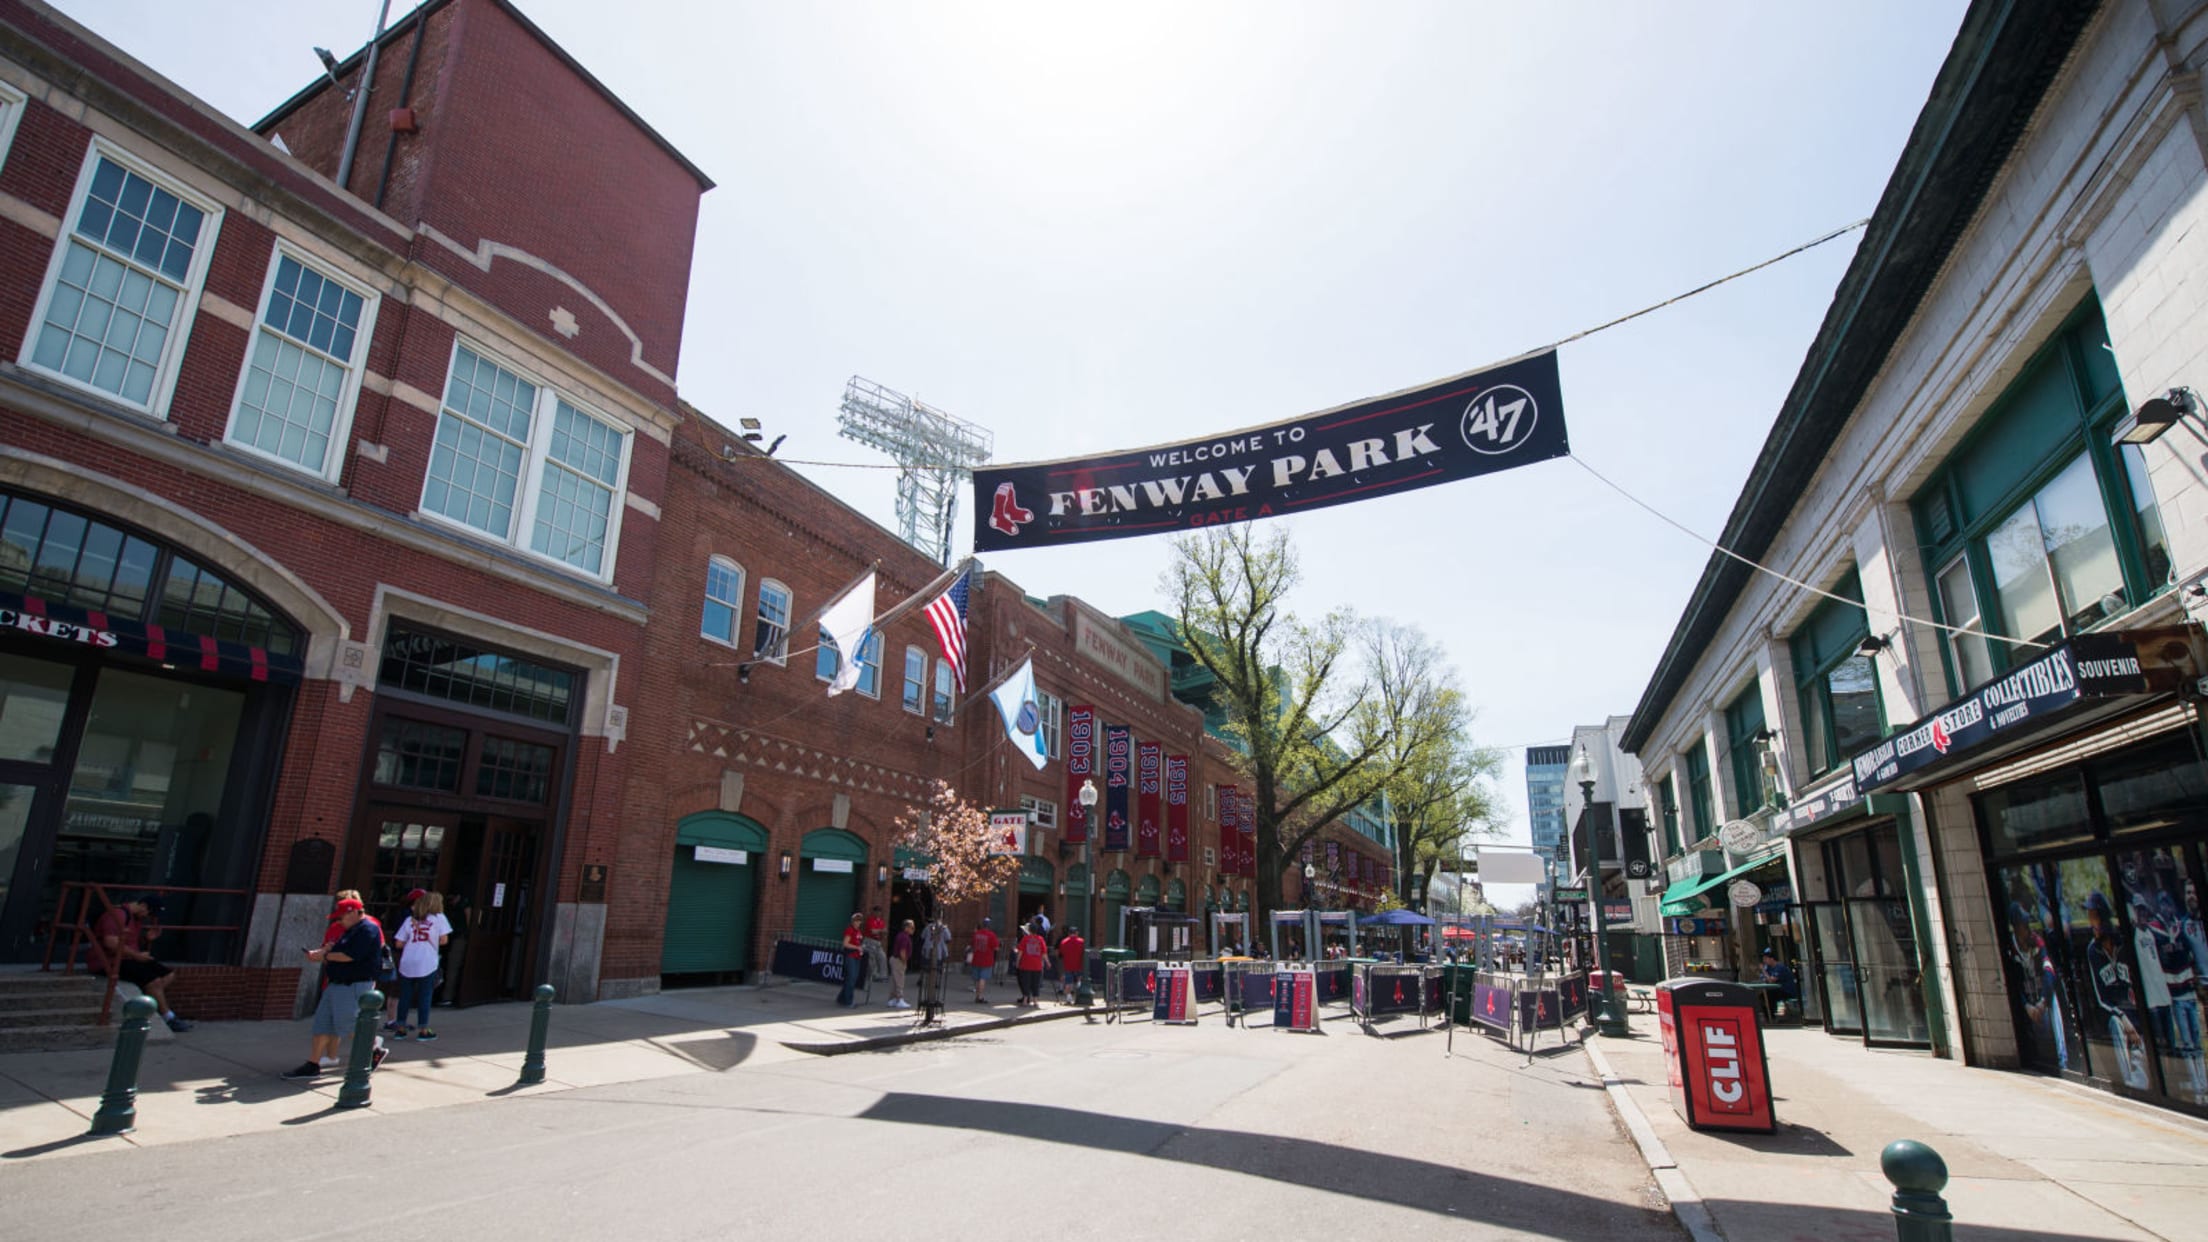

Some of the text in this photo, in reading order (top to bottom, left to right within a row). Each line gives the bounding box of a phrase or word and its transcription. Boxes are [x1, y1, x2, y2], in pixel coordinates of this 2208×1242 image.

[1048, 422, 1442, 517] FENWAY PARK
[1149, 427, 1306, 468] WELCOME TO
[1189, 503, 1274, 527] GATE A
[1085, 625, 1156, 692] FENWAY PARK
[1983, 649, 2075, 709] COLLECTIBLES
[2078, 657, 2141, 679] SOUVENIR
[1071, 711, 1091, 774] 1903
[1899, 700, 1981, 755] CORNER STORE
[1109, 729, 1129, 787] 1904
[1141, 746, 1159, 795] 1912
[1170, 759, 1187, 805] 1915
[993, 816, 1025, 825] GATE
[412, 928, 430, 943] 15
[822, 963, 844, 980] ONL
[1705, 1026, 1743, 1103] CLIF
